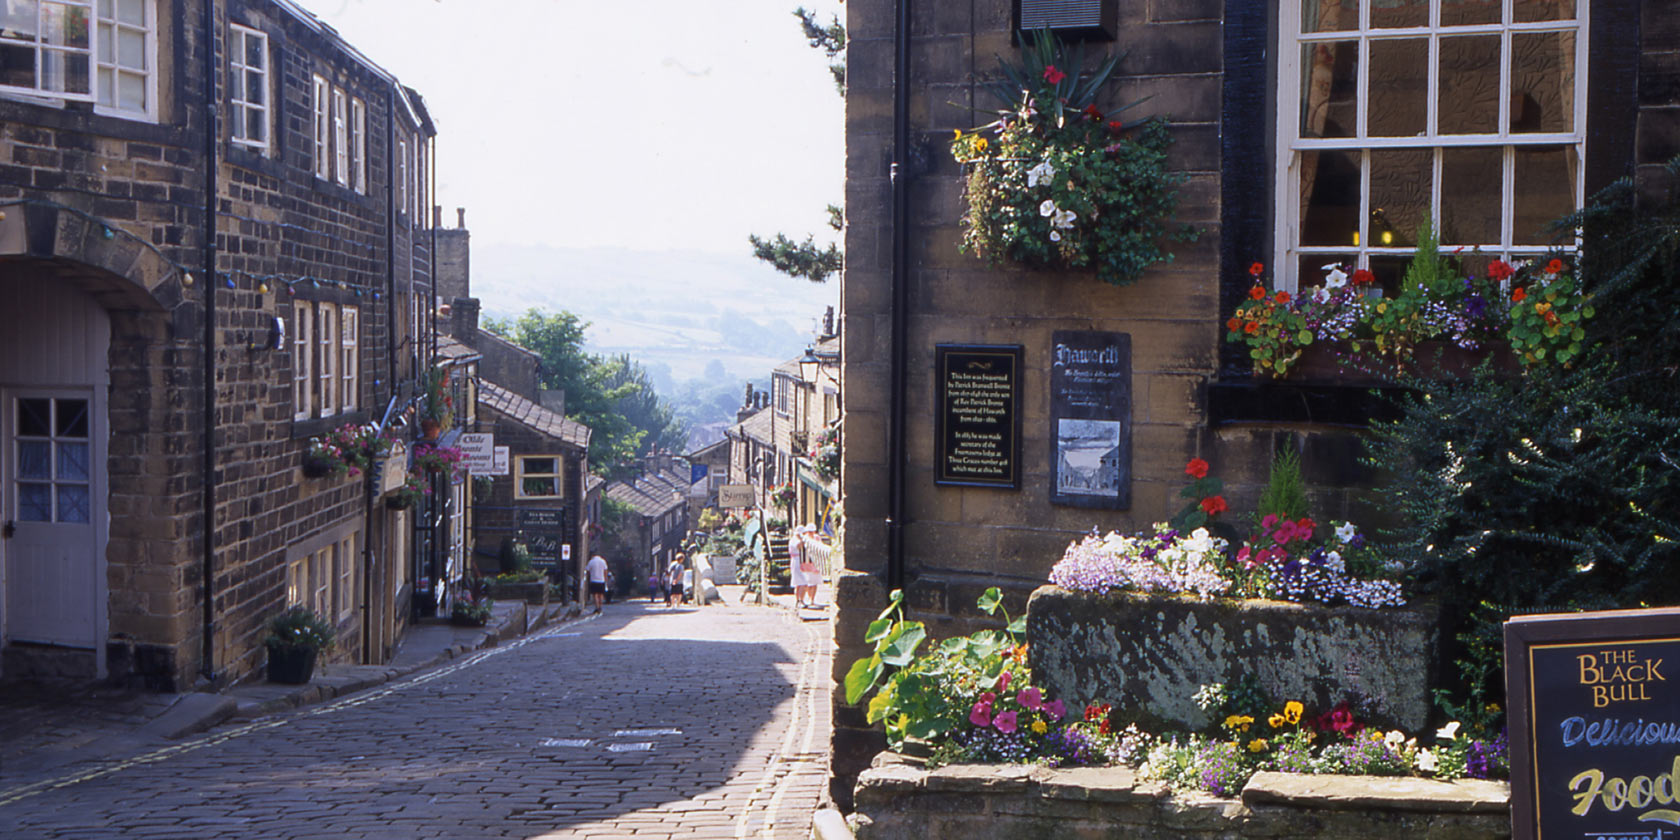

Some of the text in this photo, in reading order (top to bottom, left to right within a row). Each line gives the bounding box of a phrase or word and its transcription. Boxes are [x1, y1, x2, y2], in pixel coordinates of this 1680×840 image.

[1054, 344, 1118, 366] Haworth
[722, 490, 752, 502] Stirrup
[1600, 650, 1638, 664] THE
[1576, 654, 1666, 684] BLACK
[1592, 683, 1652, 708] BULL
[1568, 755, 1680, 816] Food
